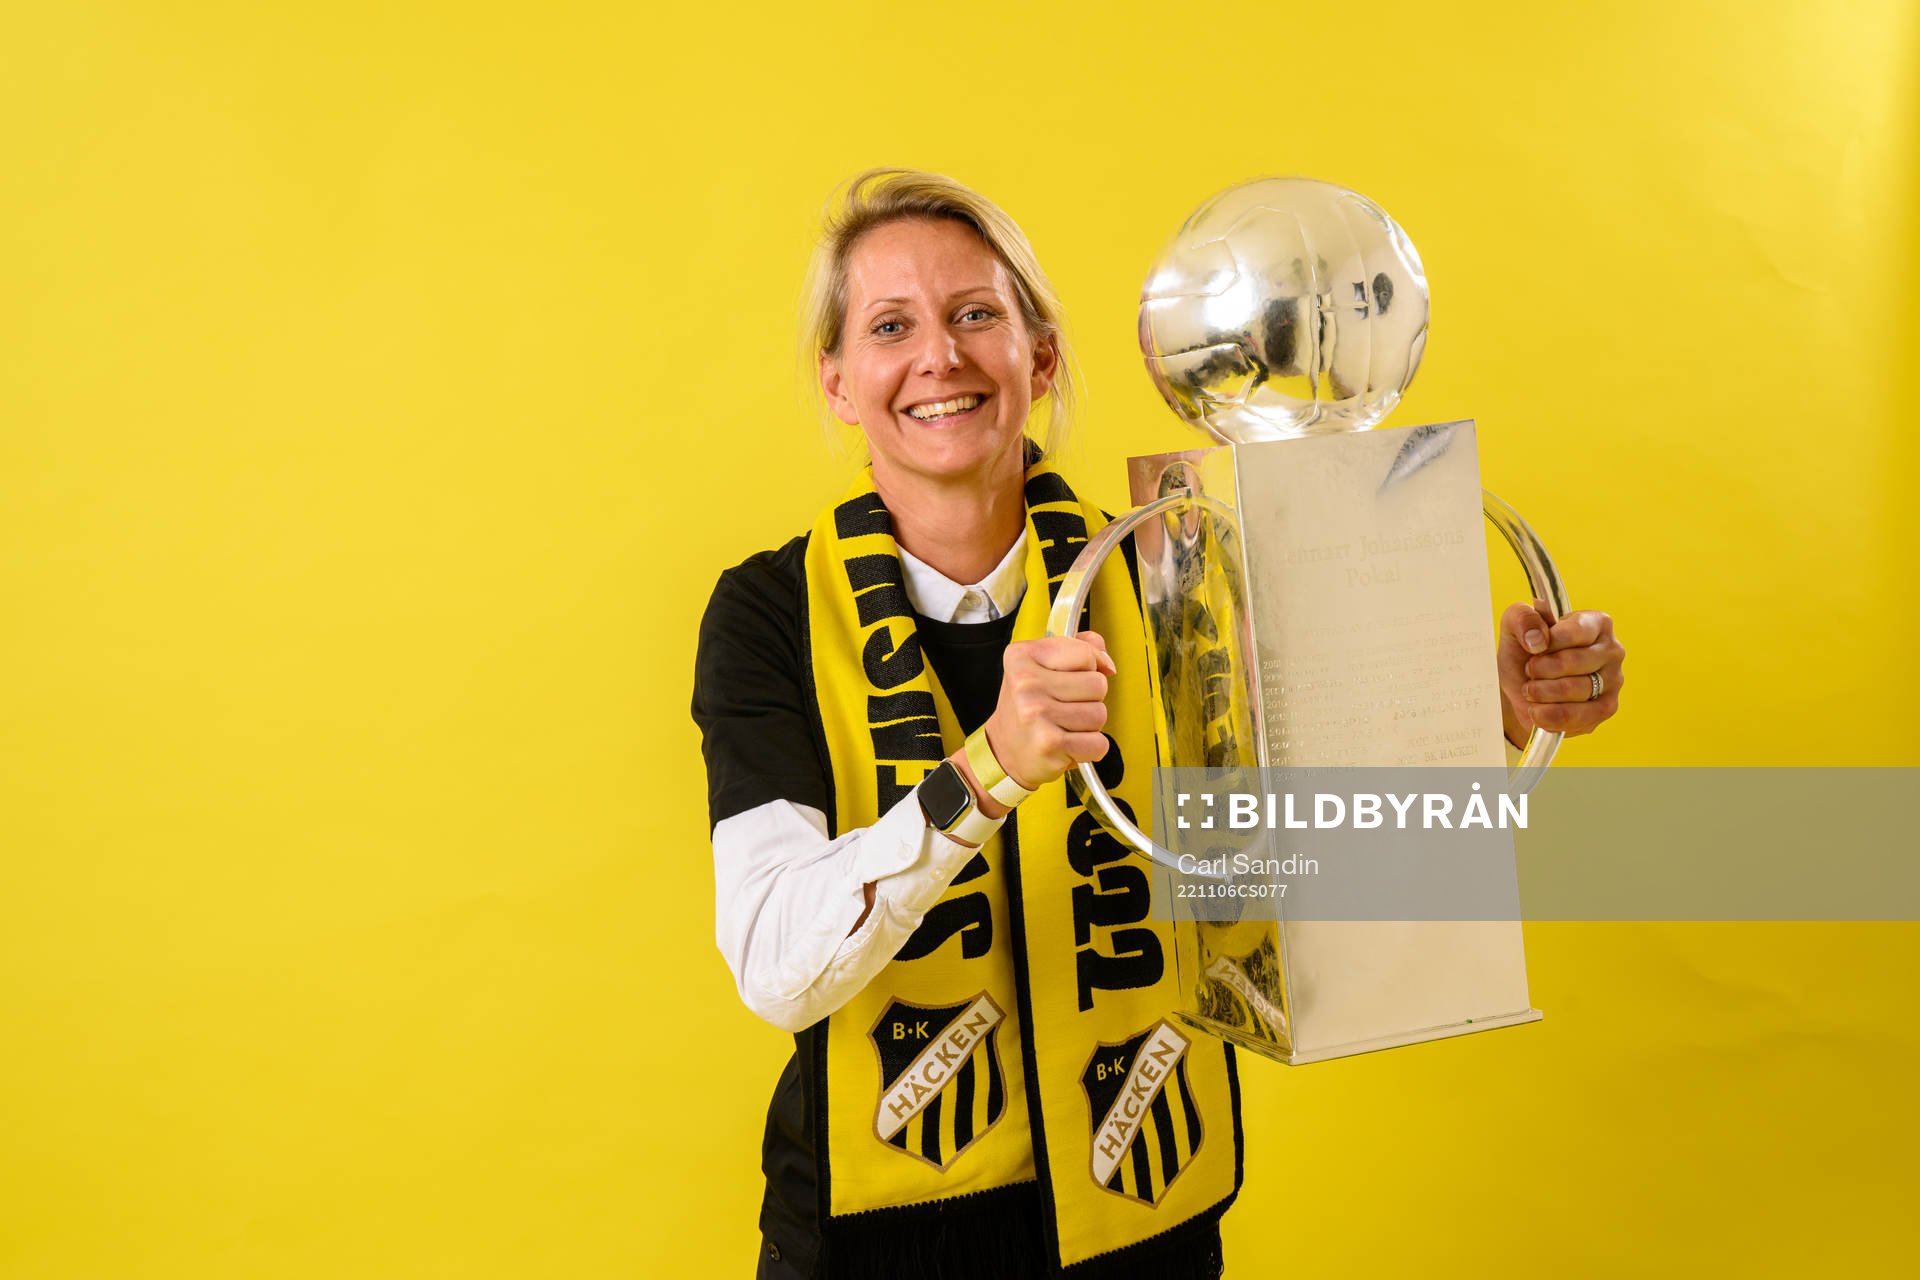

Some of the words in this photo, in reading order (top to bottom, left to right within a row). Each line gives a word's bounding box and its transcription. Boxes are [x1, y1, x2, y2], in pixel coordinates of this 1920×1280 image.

[834, 492, 993, 962] SENSKA
[888, 1011, 989, 1119] HÄCKEN
[1099, 1039, 1177, 1161] HÄCKEN
